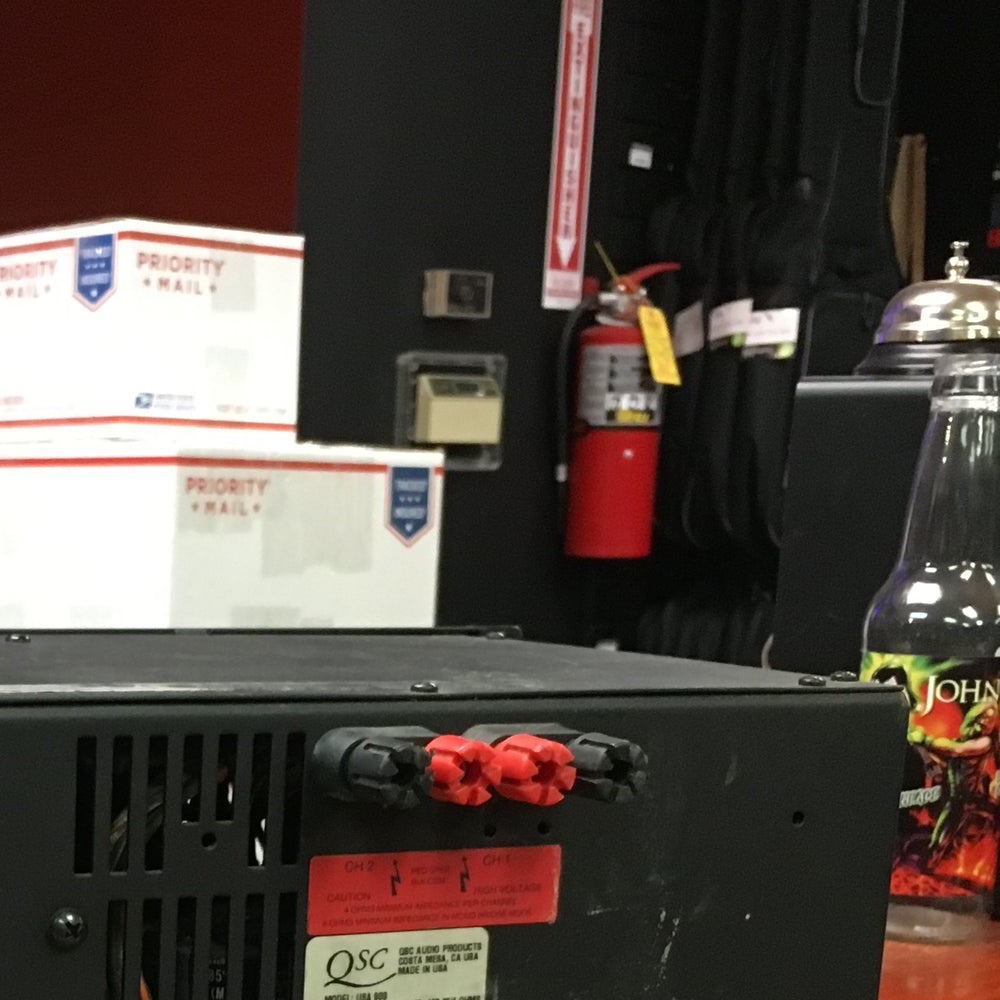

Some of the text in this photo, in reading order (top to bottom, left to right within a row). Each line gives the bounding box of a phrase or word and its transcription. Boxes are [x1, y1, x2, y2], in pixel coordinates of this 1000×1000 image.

[136, 252, 225, 277] PRIORITY
[5, 286, 39, 299] MAIL
[157, 278, 203, 295] MAIL
[185, 477, 269, 496] PRIORITY
[204, 501, 248, 516] MAIL
[921, 675, 1000, 717] JOHN
[344, 860, 364, 873] CH
[416, 945, 440, 954] AUDIO
[443, 942, 482, 952] PRODUCTS
[398, 956, 422, 965] COSTA
[451, 953, 461, 962] CA
[324, 948, 397, 988] QSC
[398, 966, 420, 975] MADE
[422, 965, 430, 973] IN
